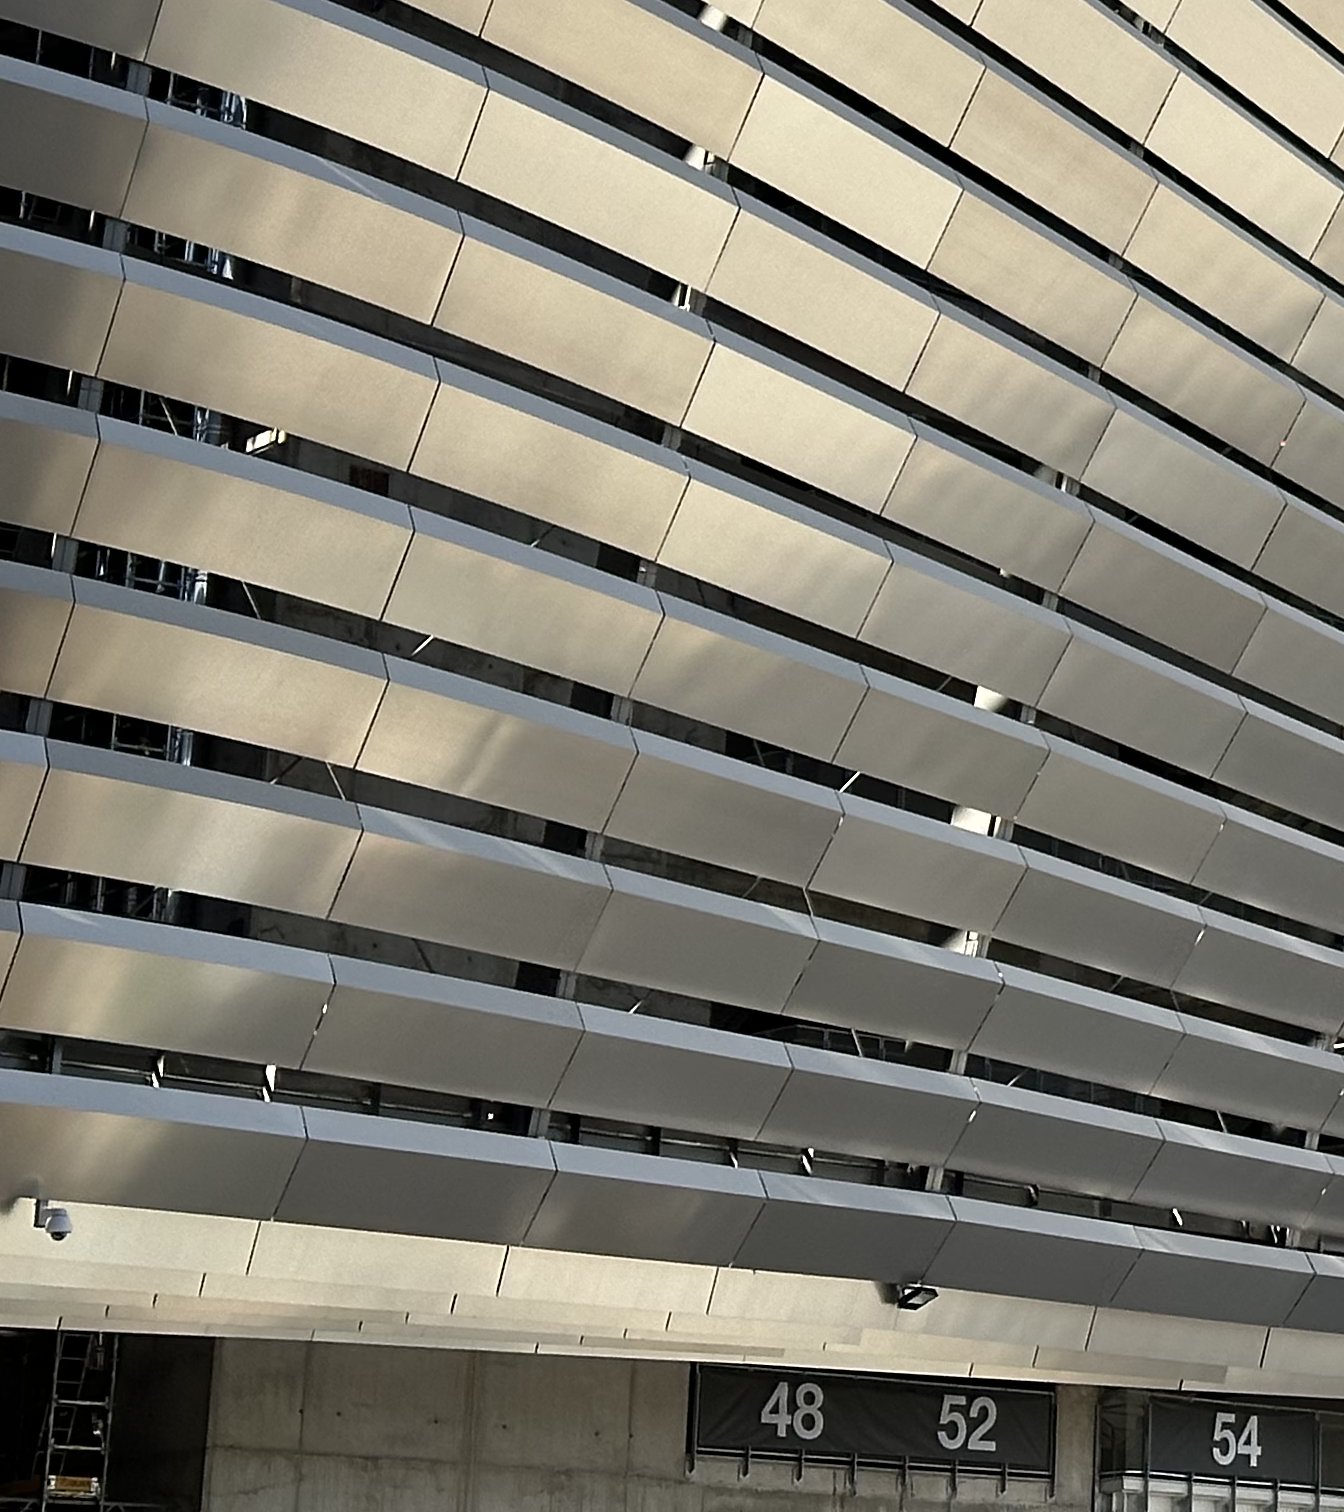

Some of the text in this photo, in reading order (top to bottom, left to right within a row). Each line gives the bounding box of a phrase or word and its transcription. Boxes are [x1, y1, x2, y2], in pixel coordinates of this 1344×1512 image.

[761, 1382, 997, 1452] 48 52
[1212, 1412, 1262, 1468] 54
